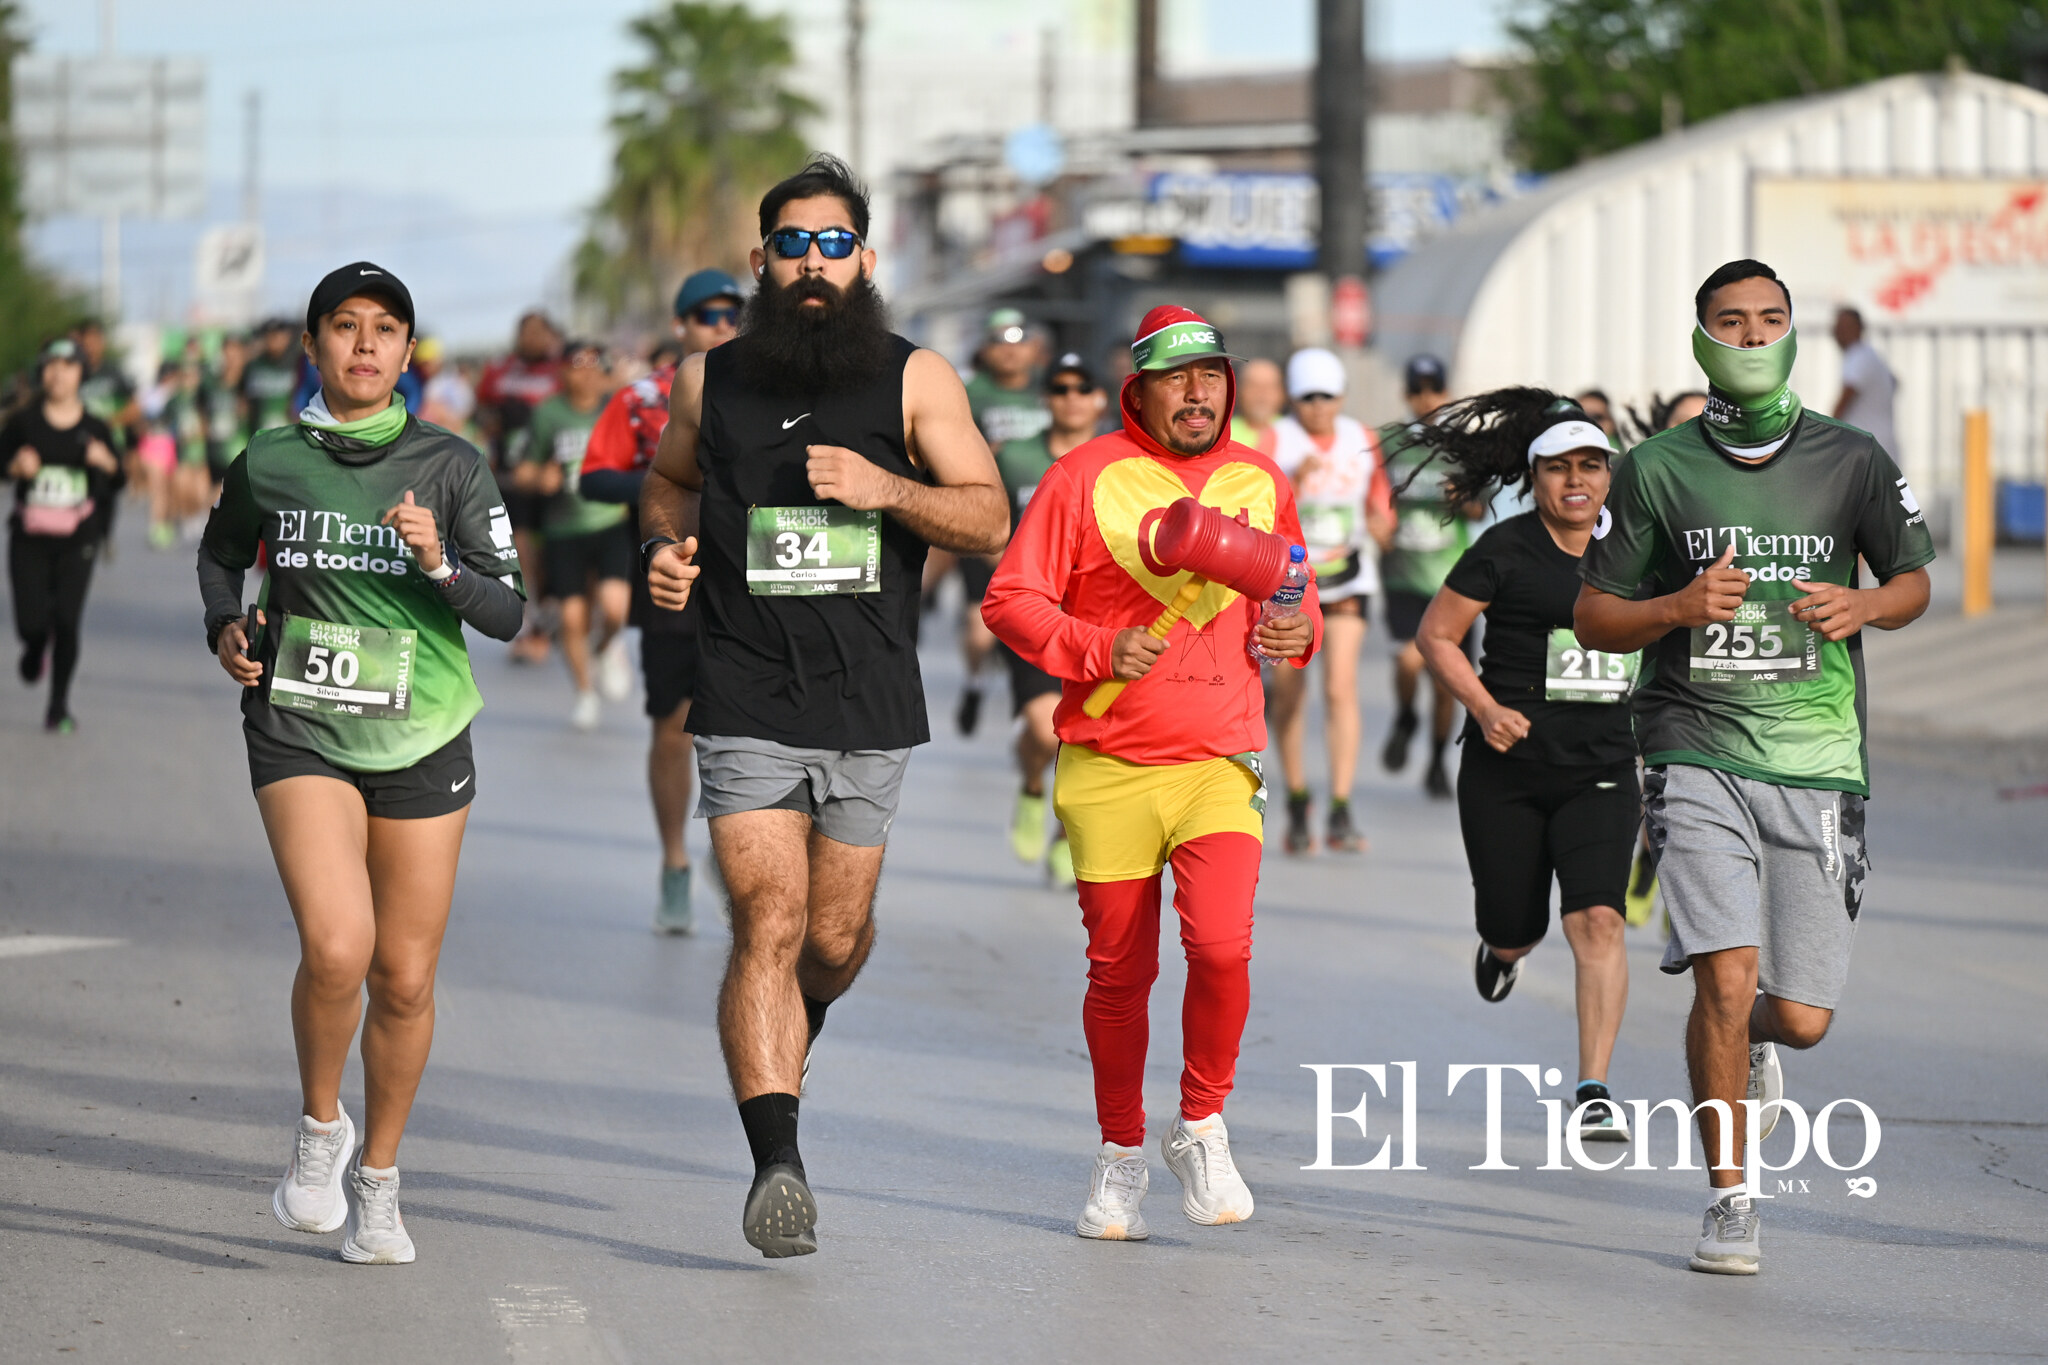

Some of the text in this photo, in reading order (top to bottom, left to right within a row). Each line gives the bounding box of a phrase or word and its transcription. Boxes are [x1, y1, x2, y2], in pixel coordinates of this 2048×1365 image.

[276, 510, 306, 542] El
[276, 547, 408, 575] de todos
[776, 532, 831, 568] 34
[866, 525, 877, 582] MEDALLA
[1683, 526, 1835, 563] El Tiempo
[310, 622, 361, 636] CARRERA
[401, 637, 411, 645] 50
[1704, 623, 1783, 658] 255
[305, 646, 359, 687] 50
[395, 651, 410, 710] MEDALLA
[1561, 649, 1624, 680] 215
[316, 687, 340, 697] Silvia
